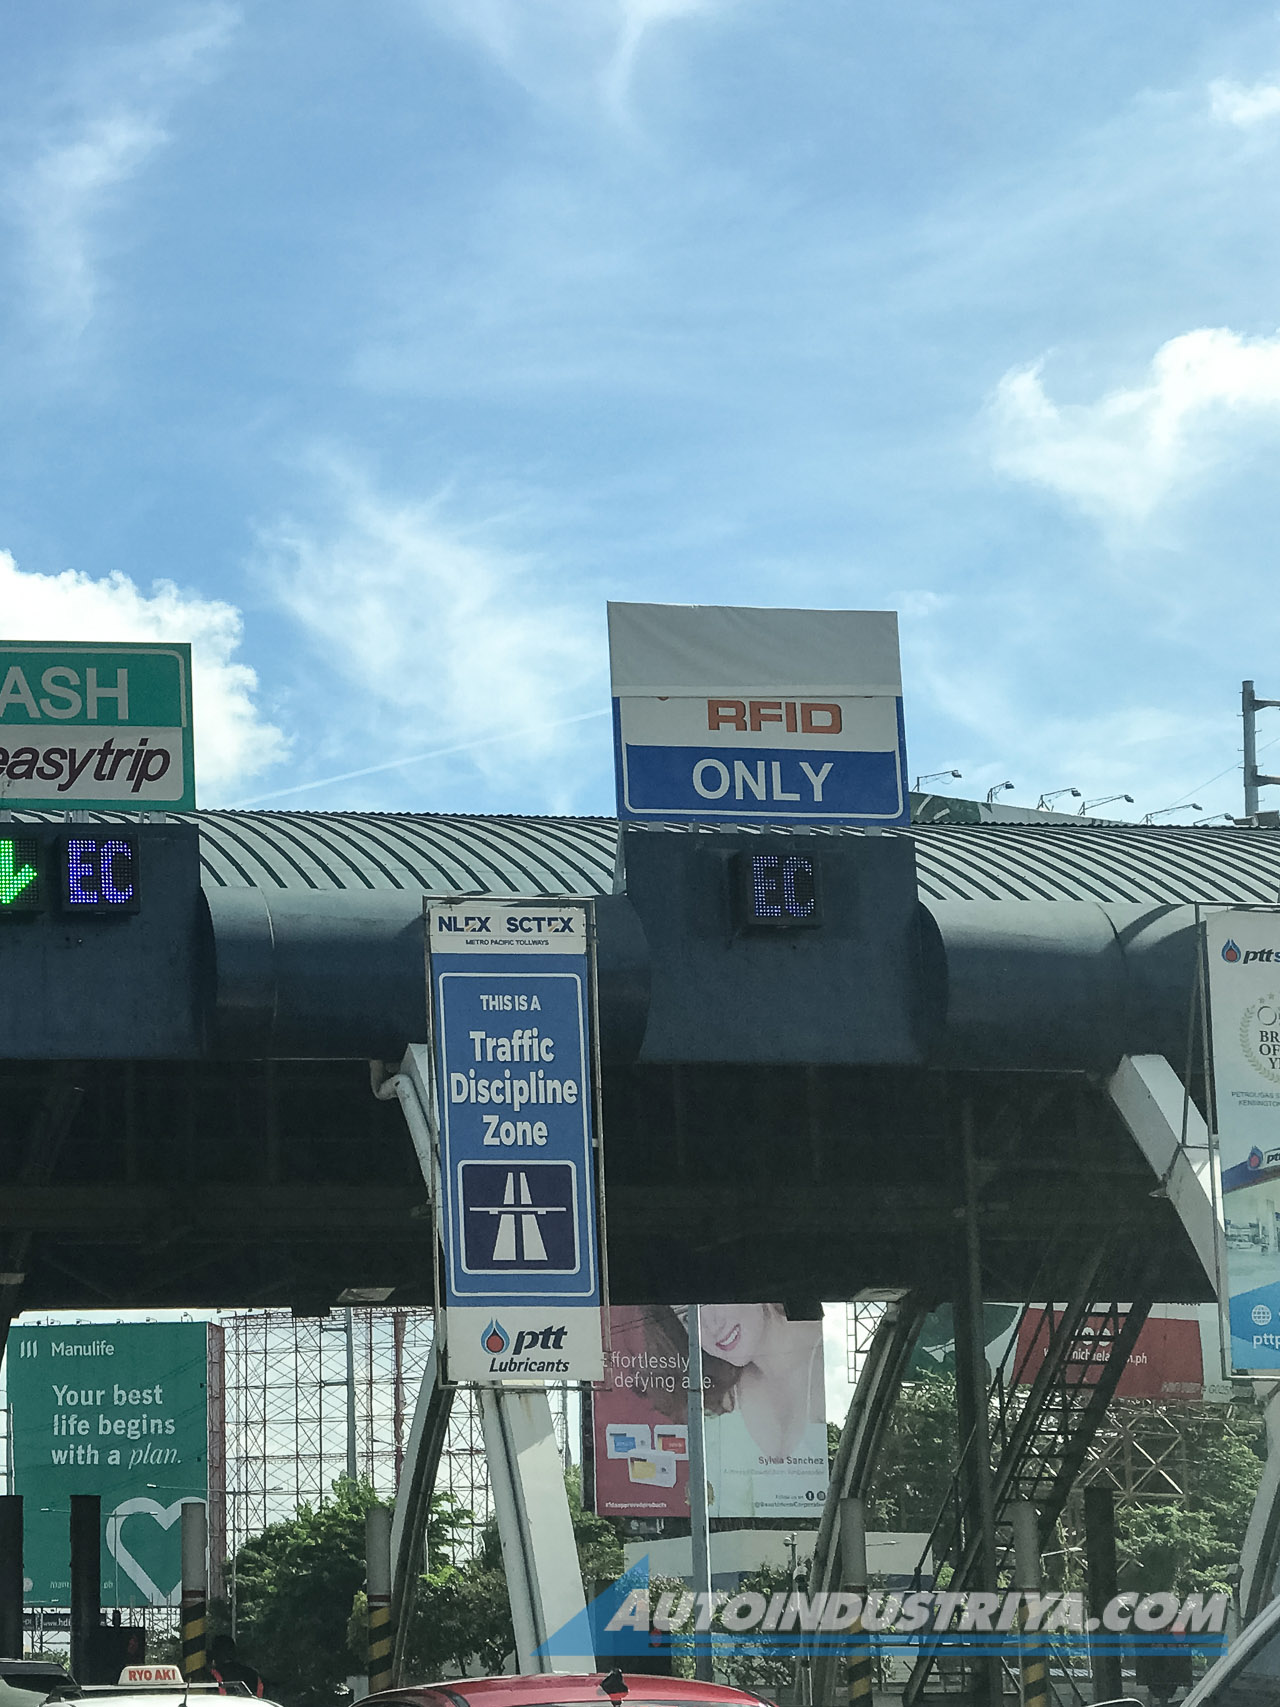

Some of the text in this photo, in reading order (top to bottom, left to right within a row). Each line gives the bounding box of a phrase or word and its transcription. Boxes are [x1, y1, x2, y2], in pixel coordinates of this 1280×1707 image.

[707, 698, 843, 734] RFID
[692, 758, 834, 802] ONLY
[68, 840, 133, 903] EC
[752, 856, 815, 917] EC
[438, 916, 574, 933] NLEX SCTEX
[480, 995, 542, 1011] THIS IS A
[469, 1027, 555, 1062] Traffic
[450, 1069, 578, 1112] Discipline
[482, 1114, 548, 1146] Zone
[51, 1342, 115, 1358] Manulife
[512, 1325, 568, 1355] ptt
[489, 1357, 570, 1373] Lubricants
[52, 1384, 163, 1407] Your best
[614, 1373, 716, 1392] defying ae.
[53, 1414, 175, 1440] life begins
[51, 1442, 182, 1469] with a plan.
[786, 1456, 824, 1465] Sanchez
[129, 1669, 176, 1681] RYO AKI
